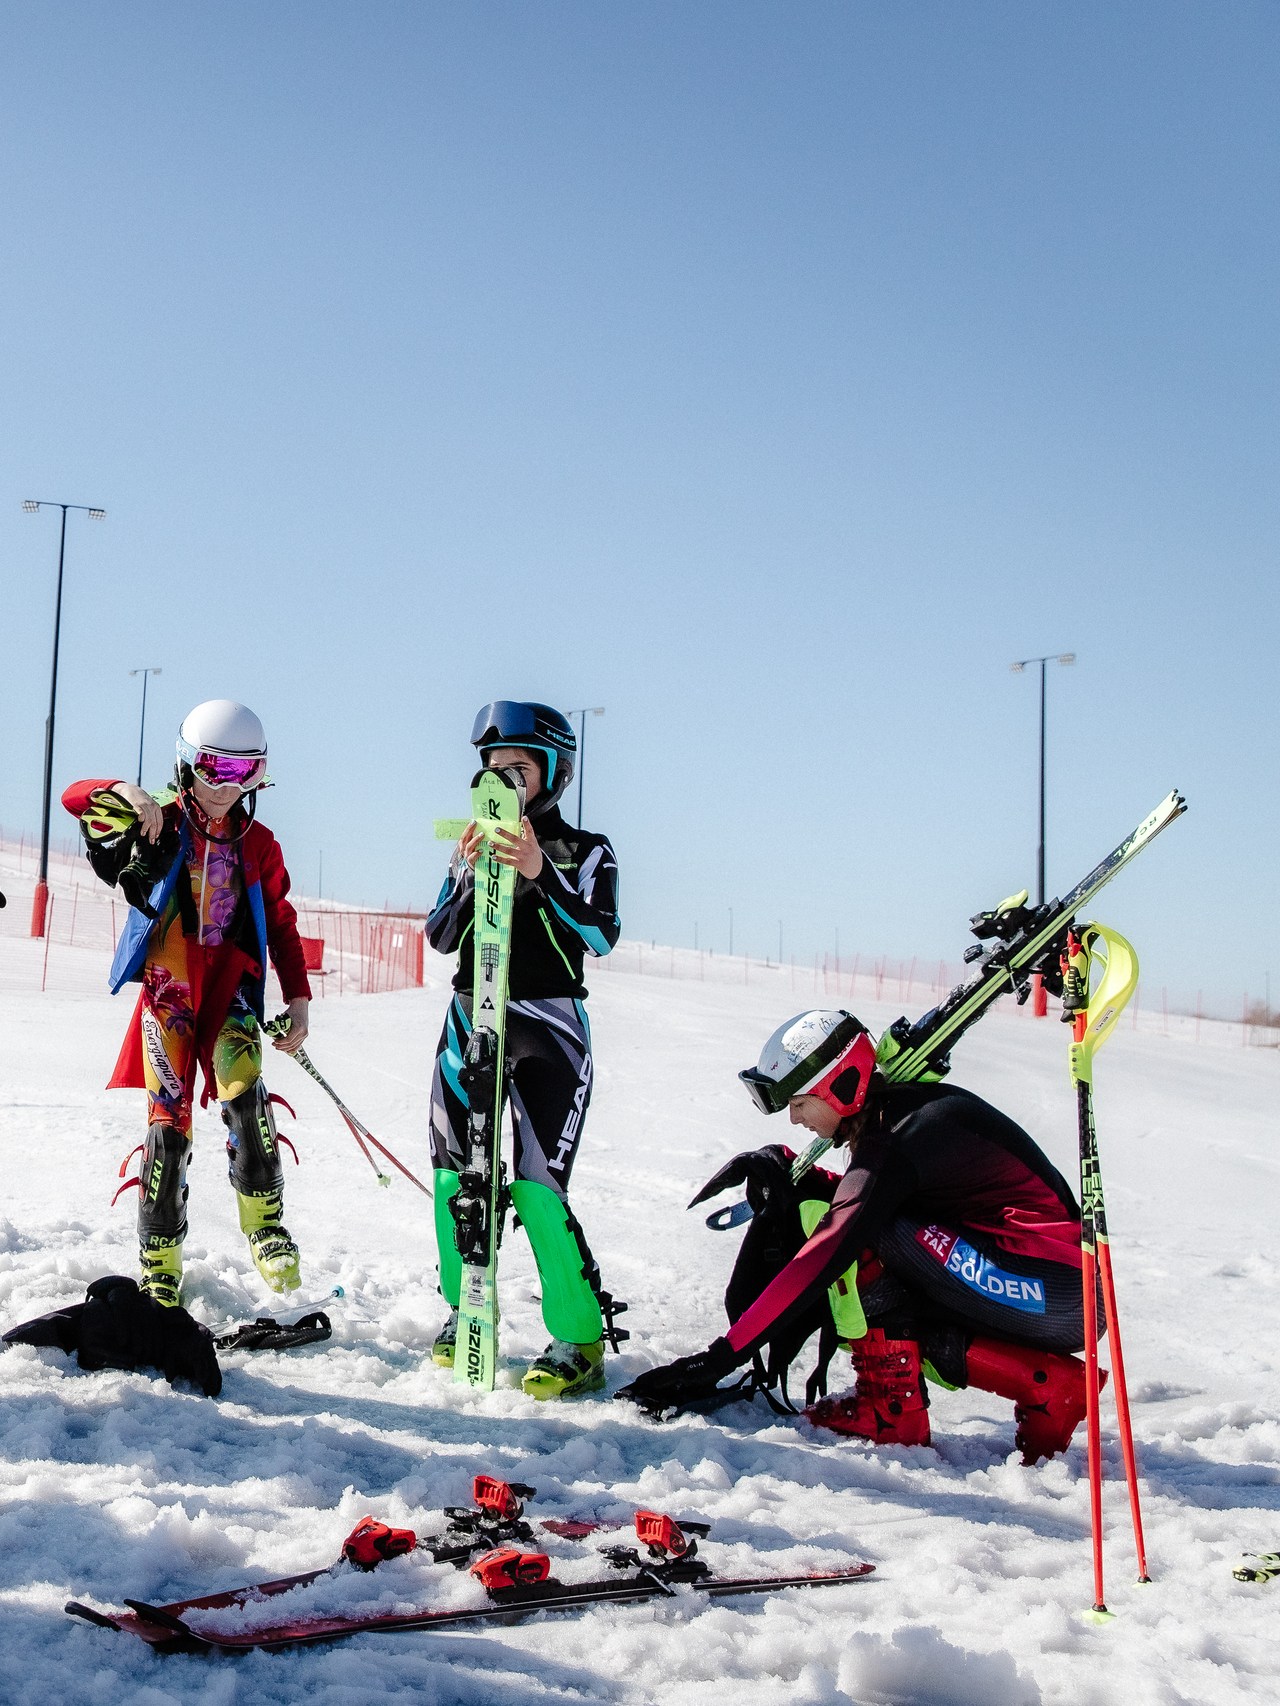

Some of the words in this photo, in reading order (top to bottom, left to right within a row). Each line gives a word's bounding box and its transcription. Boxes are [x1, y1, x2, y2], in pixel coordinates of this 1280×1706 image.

[546, 729, 576, 746] HEAD
[487, 799, 500, 929] FISCR
[1075, 976, 1083, 997] LEKI
[548, 1052, 592, 1171] HEAD
[258, 1117, 273, 1154] LEKI
[149, 1160, 163, 1201] LEKI
[1081, 1159, 1094, 1220] LEKI
[1091, 1156, 1105, 1212] LEKI
[150, 1235, 177, 1248] RC4
[923, 1229, 945, 1257] TAL
[949, 1252, 1043, 1301] SÖLDEN
[468, 1323, 481, 1381] NOIZE
